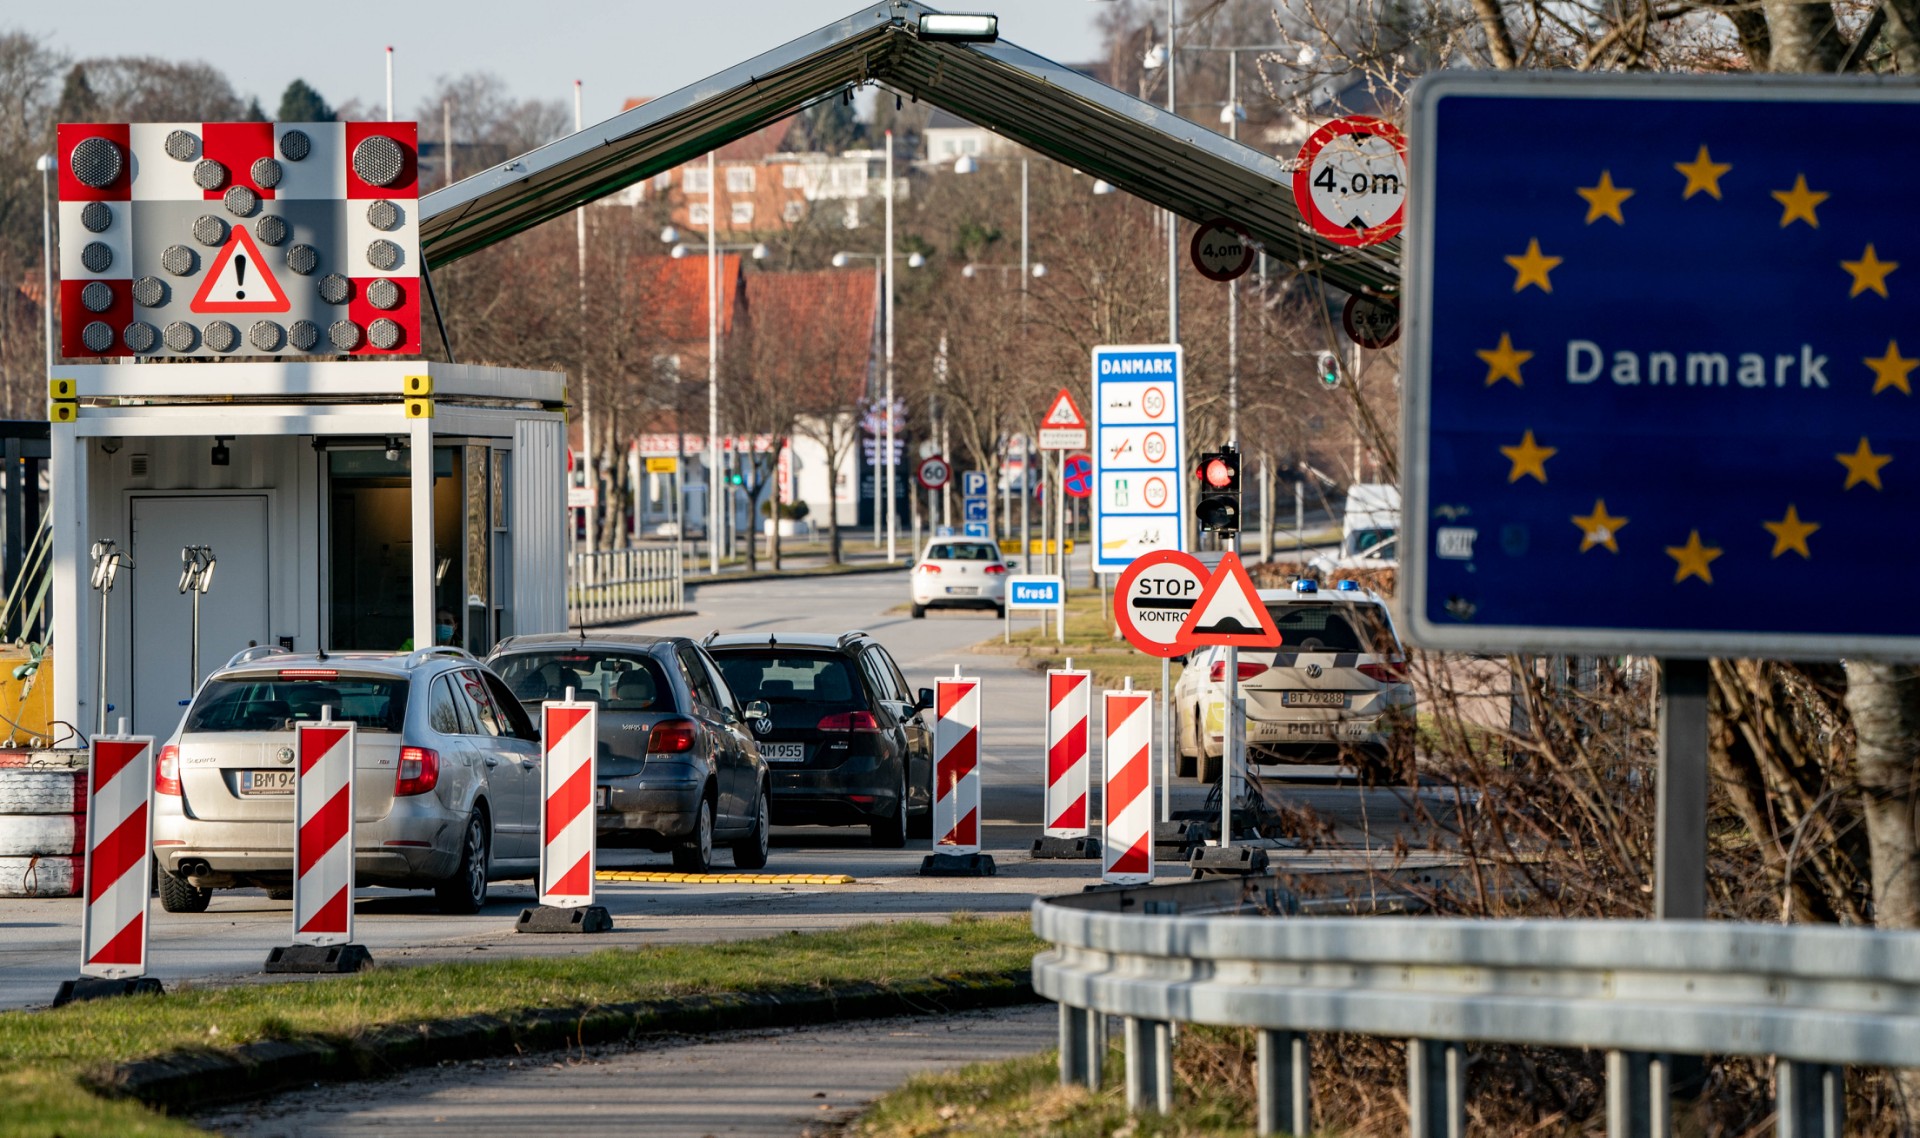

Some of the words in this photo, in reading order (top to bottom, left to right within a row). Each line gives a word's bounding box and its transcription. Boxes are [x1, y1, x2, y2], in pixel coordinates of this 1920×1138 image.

[1101, 358, 1173, 375] DANMARK
[1566, 339, 1830, 388] Danmark
[1147, 396, 1162, 409] 50
[1148, 441, 1163, 454] 80
[923, 465, 945, 480] 60
[969, 474, 985, 495] P
[1017, 585, 1053, 600] Kruså
[1139, 578, 1196, 596] STOP
[1290, 692, 1305, 703] BT
[1307, 692, 1320, 703] 79
[1322, 692, 1343, 704] 288
[778, 745, 802, 757] 955
[254, 773, 275, 788] BM
